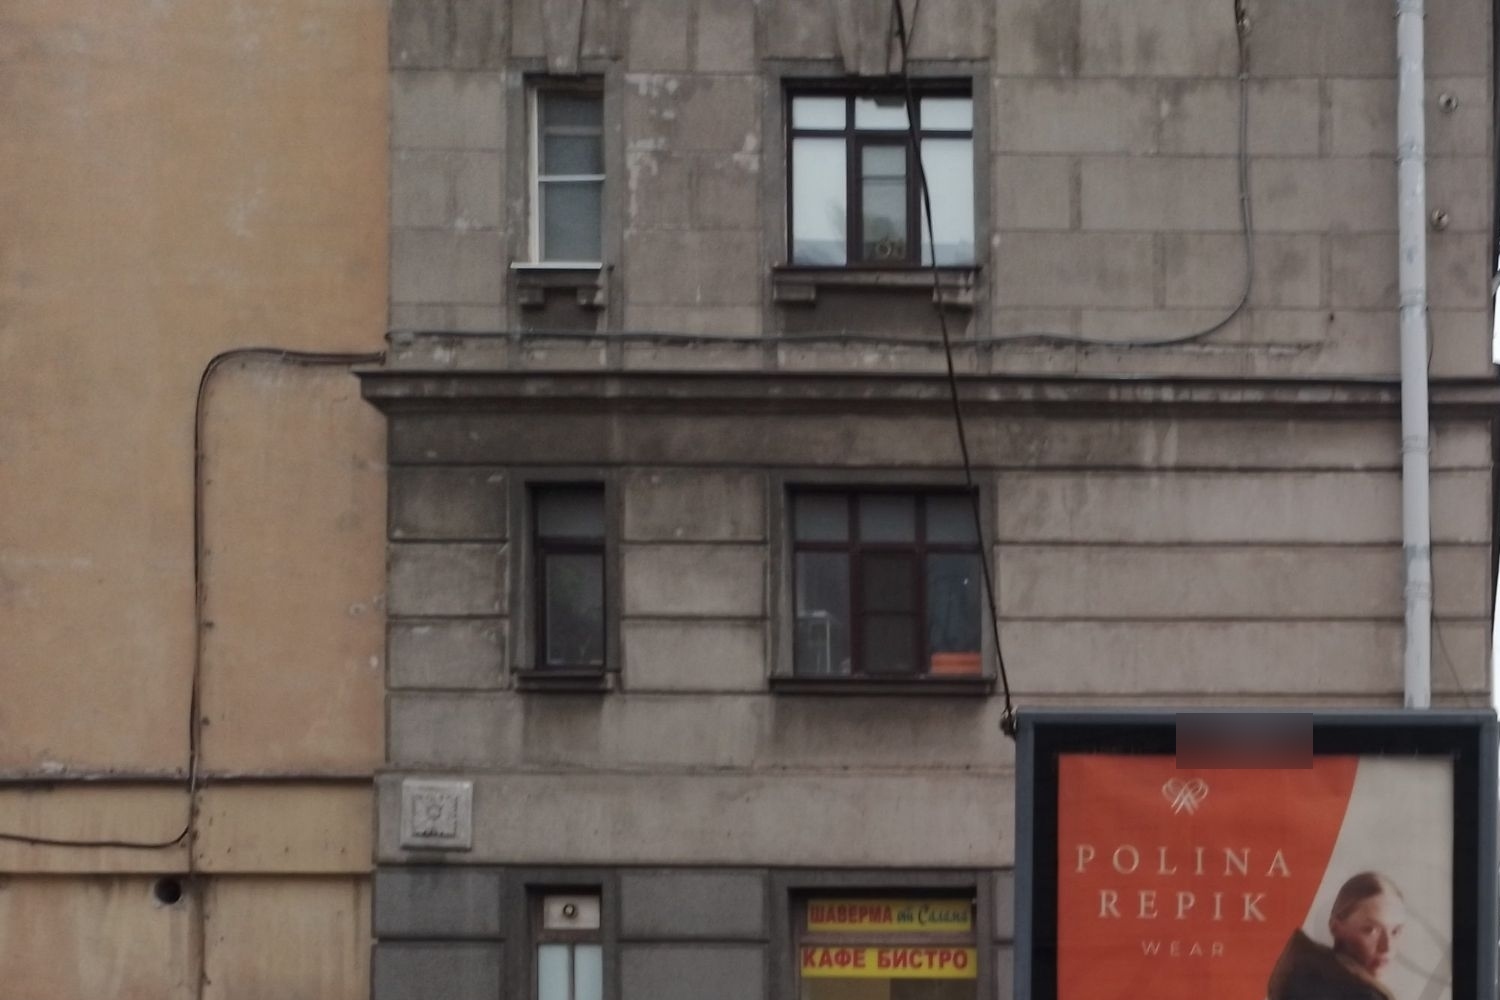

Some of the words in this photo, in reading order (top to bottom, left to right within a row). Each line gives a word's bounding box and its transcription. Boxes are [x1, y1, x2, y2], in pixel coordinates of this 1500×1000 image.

[1075, 844, 1291, 877] POLINA
[810, 904, 892, 924] ШАВЕРМА
[1098, 890, 1267, 922] REPIK
[803, 948, 866, 968] КАФЕ
[877, 949, 968, 969] БИСТРО
[1141, 939, 1225, 957] WEAR
